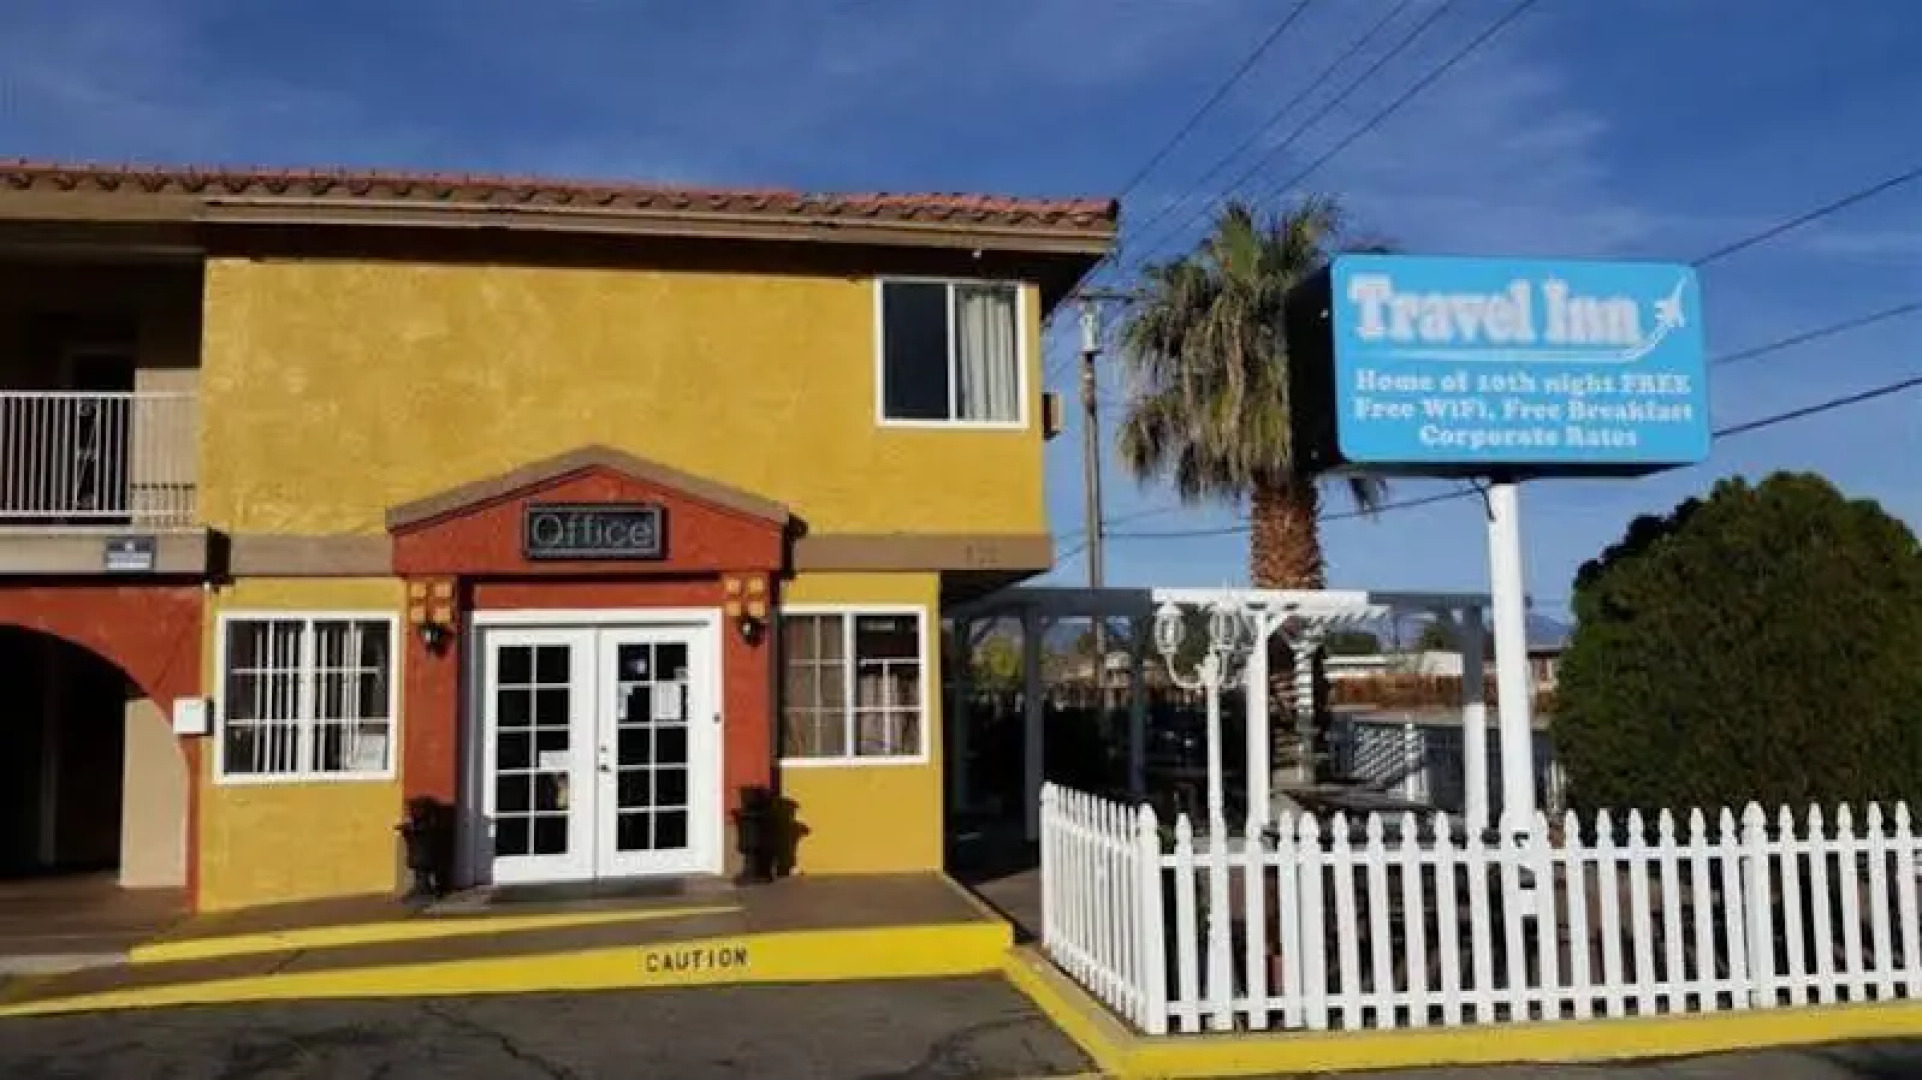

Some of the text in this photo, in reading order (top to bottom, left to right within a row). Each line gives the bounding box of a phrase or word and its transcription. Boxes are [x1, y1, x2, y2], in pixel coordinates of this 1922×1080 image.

[1347, 274, 1641, 344] Travel Inn
[1356, 369, 1692, 396] Home of 10th night FREE
[1355, 397, 1414, 418] Free
[1503, 399, 1560, 421] Free
[1568, 400, 1693, 422] Breakfast
[1419, 425, 1637, 449] Corporate Rates
[532, 513, 653, 547] Office
[645, 947, 748, 972] CAUTION
